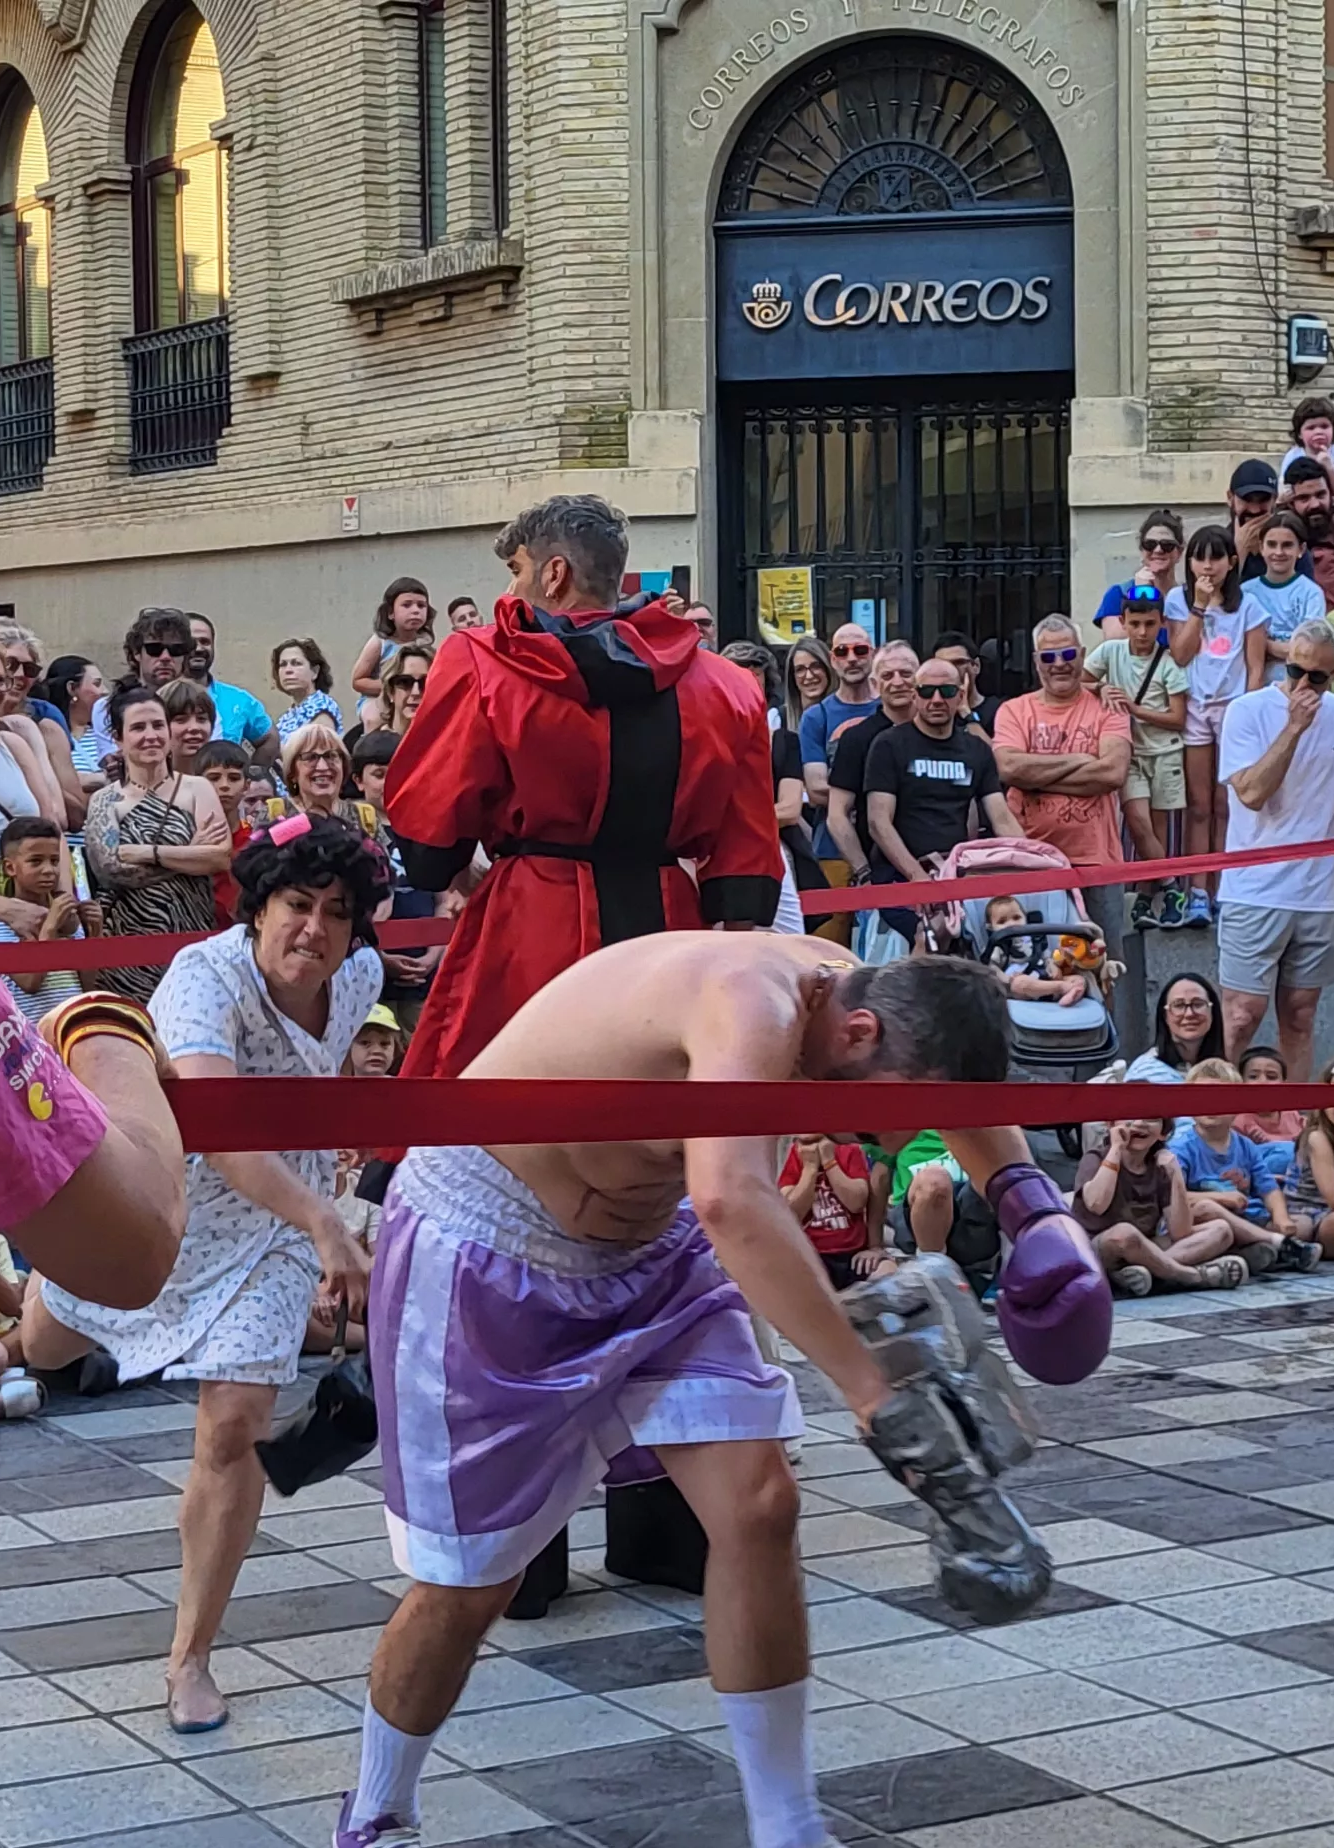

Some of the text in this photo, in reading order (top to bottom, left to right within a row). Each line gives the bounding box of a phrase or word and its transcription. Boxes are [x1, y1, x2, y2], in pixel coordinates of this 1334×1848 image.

[687, 7, 810, 132] CORREOS
[803, 273, 1052, 326] CORREOS
[914, 759, 966, 780] PUMA
